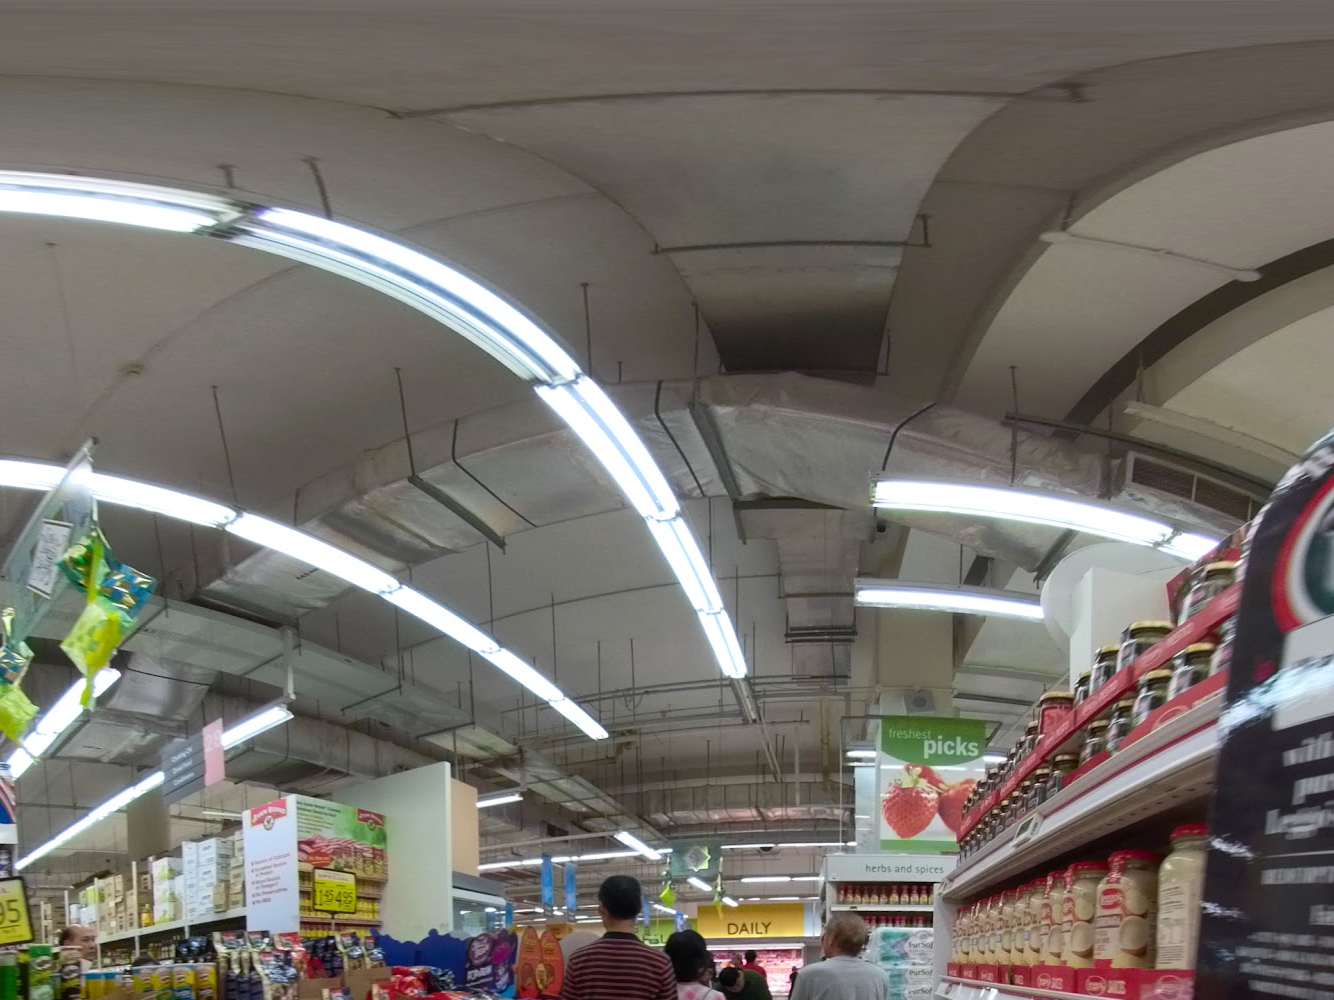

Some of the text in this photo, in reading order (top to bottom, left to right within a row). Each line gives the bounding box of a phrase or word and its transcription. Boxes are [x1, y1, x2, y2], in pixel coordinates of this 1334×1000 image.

[888, 728, 932, 740] freshest
[923, 735, 979, 759] picks
[866, 864, 944, 877] herbs and spices
[727, 921, 771, 935] DAILY
[908, 941, 933, 949] PurSof
[908, 987, 932, 995] PurSof
